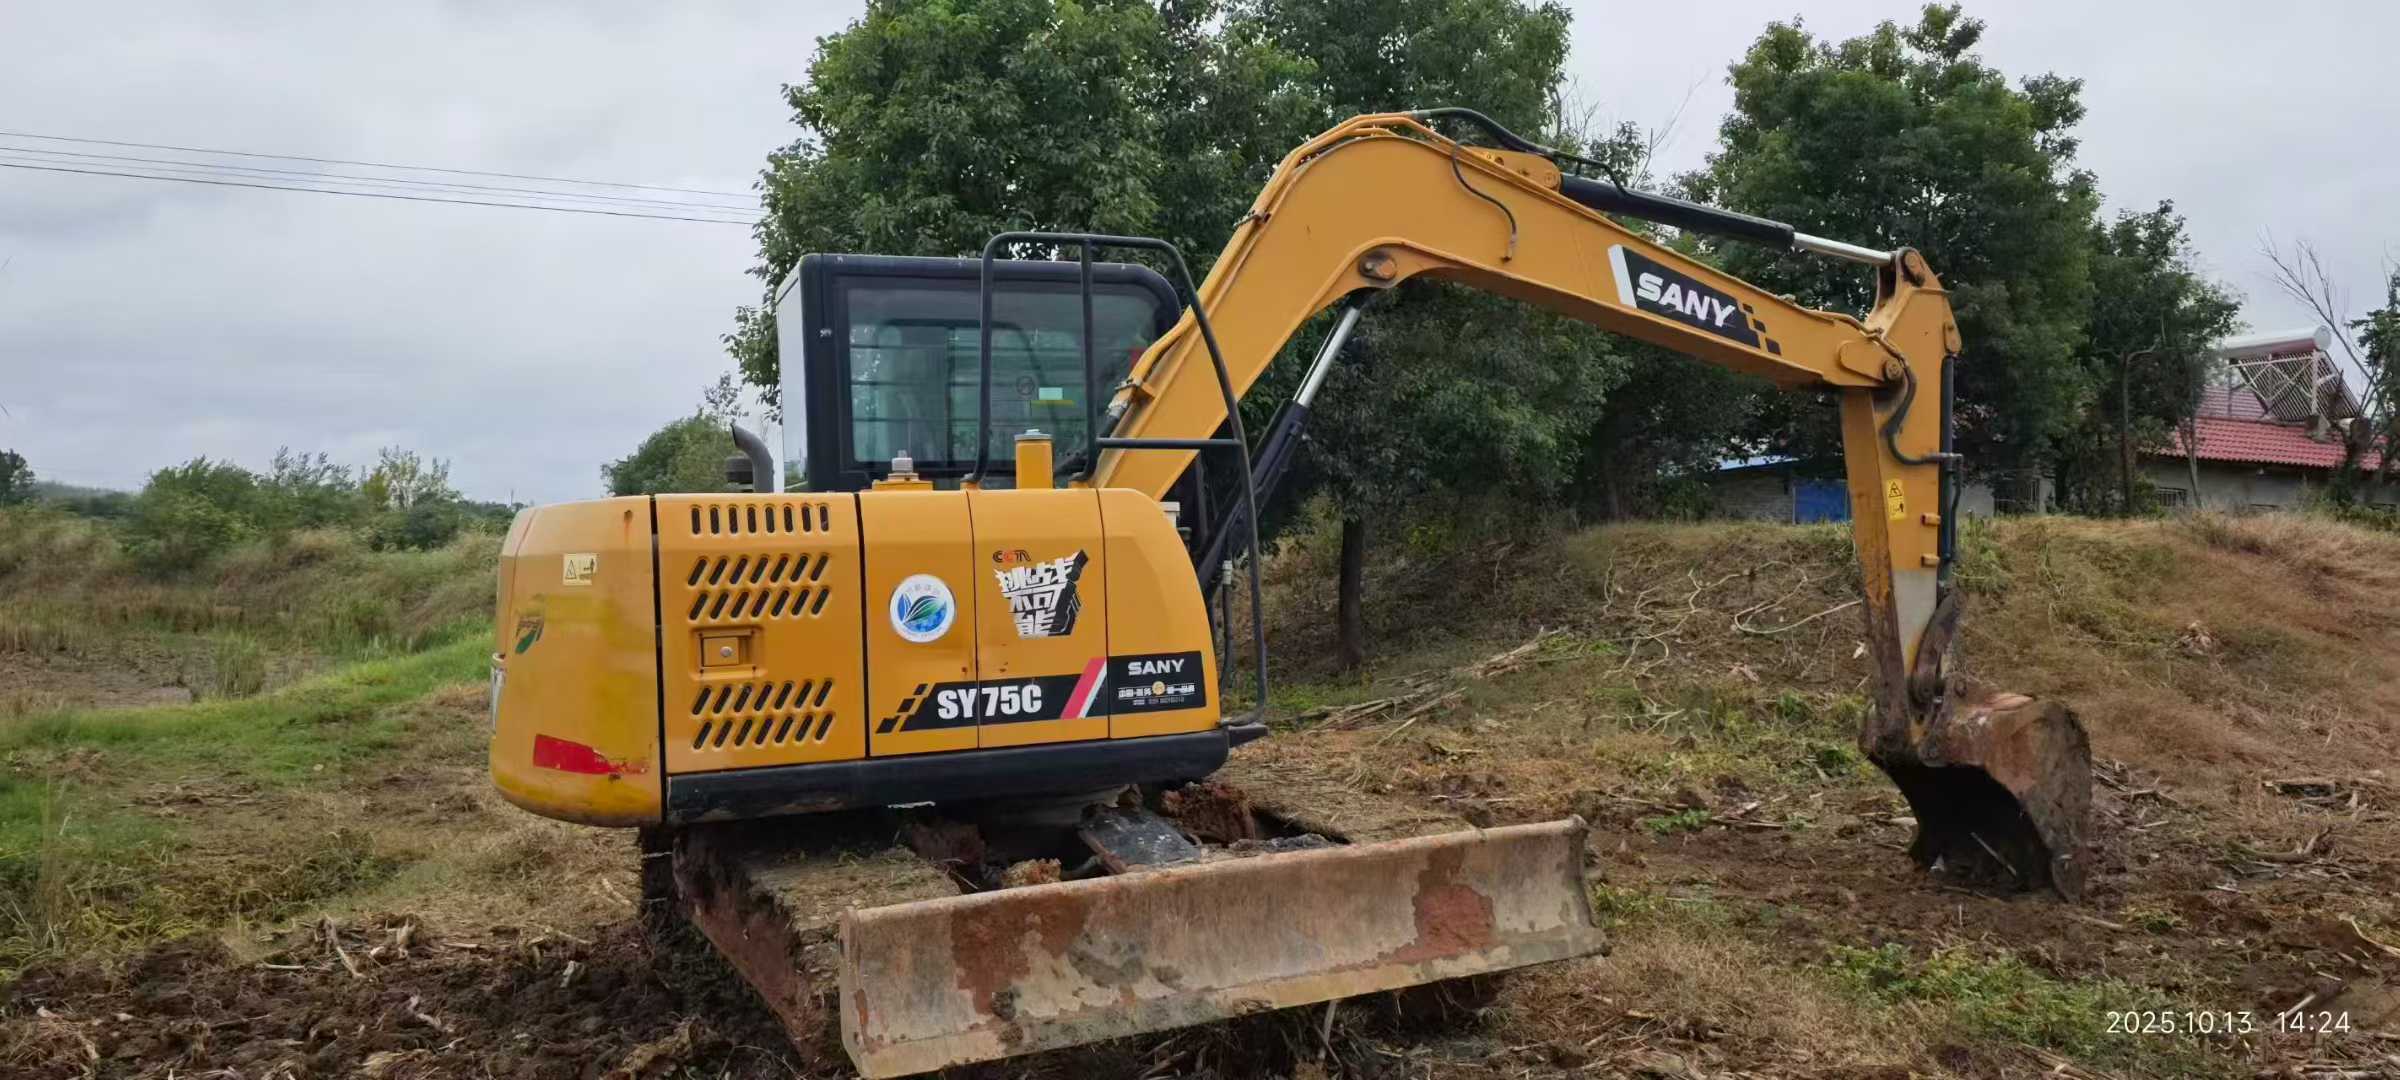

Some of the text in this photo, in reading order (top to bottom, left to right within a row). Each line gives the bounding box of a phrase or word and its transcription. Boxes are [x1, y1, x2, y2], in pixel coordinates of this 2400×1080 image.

[1636, 272, 1735, 327] SANY
[994, 555, 1076, 592] 挑战
[1002, 582, 1068, 613] 不可
[1014, 609, 1057, 639] 能
[1128, 658, 1185, 676] SANY
